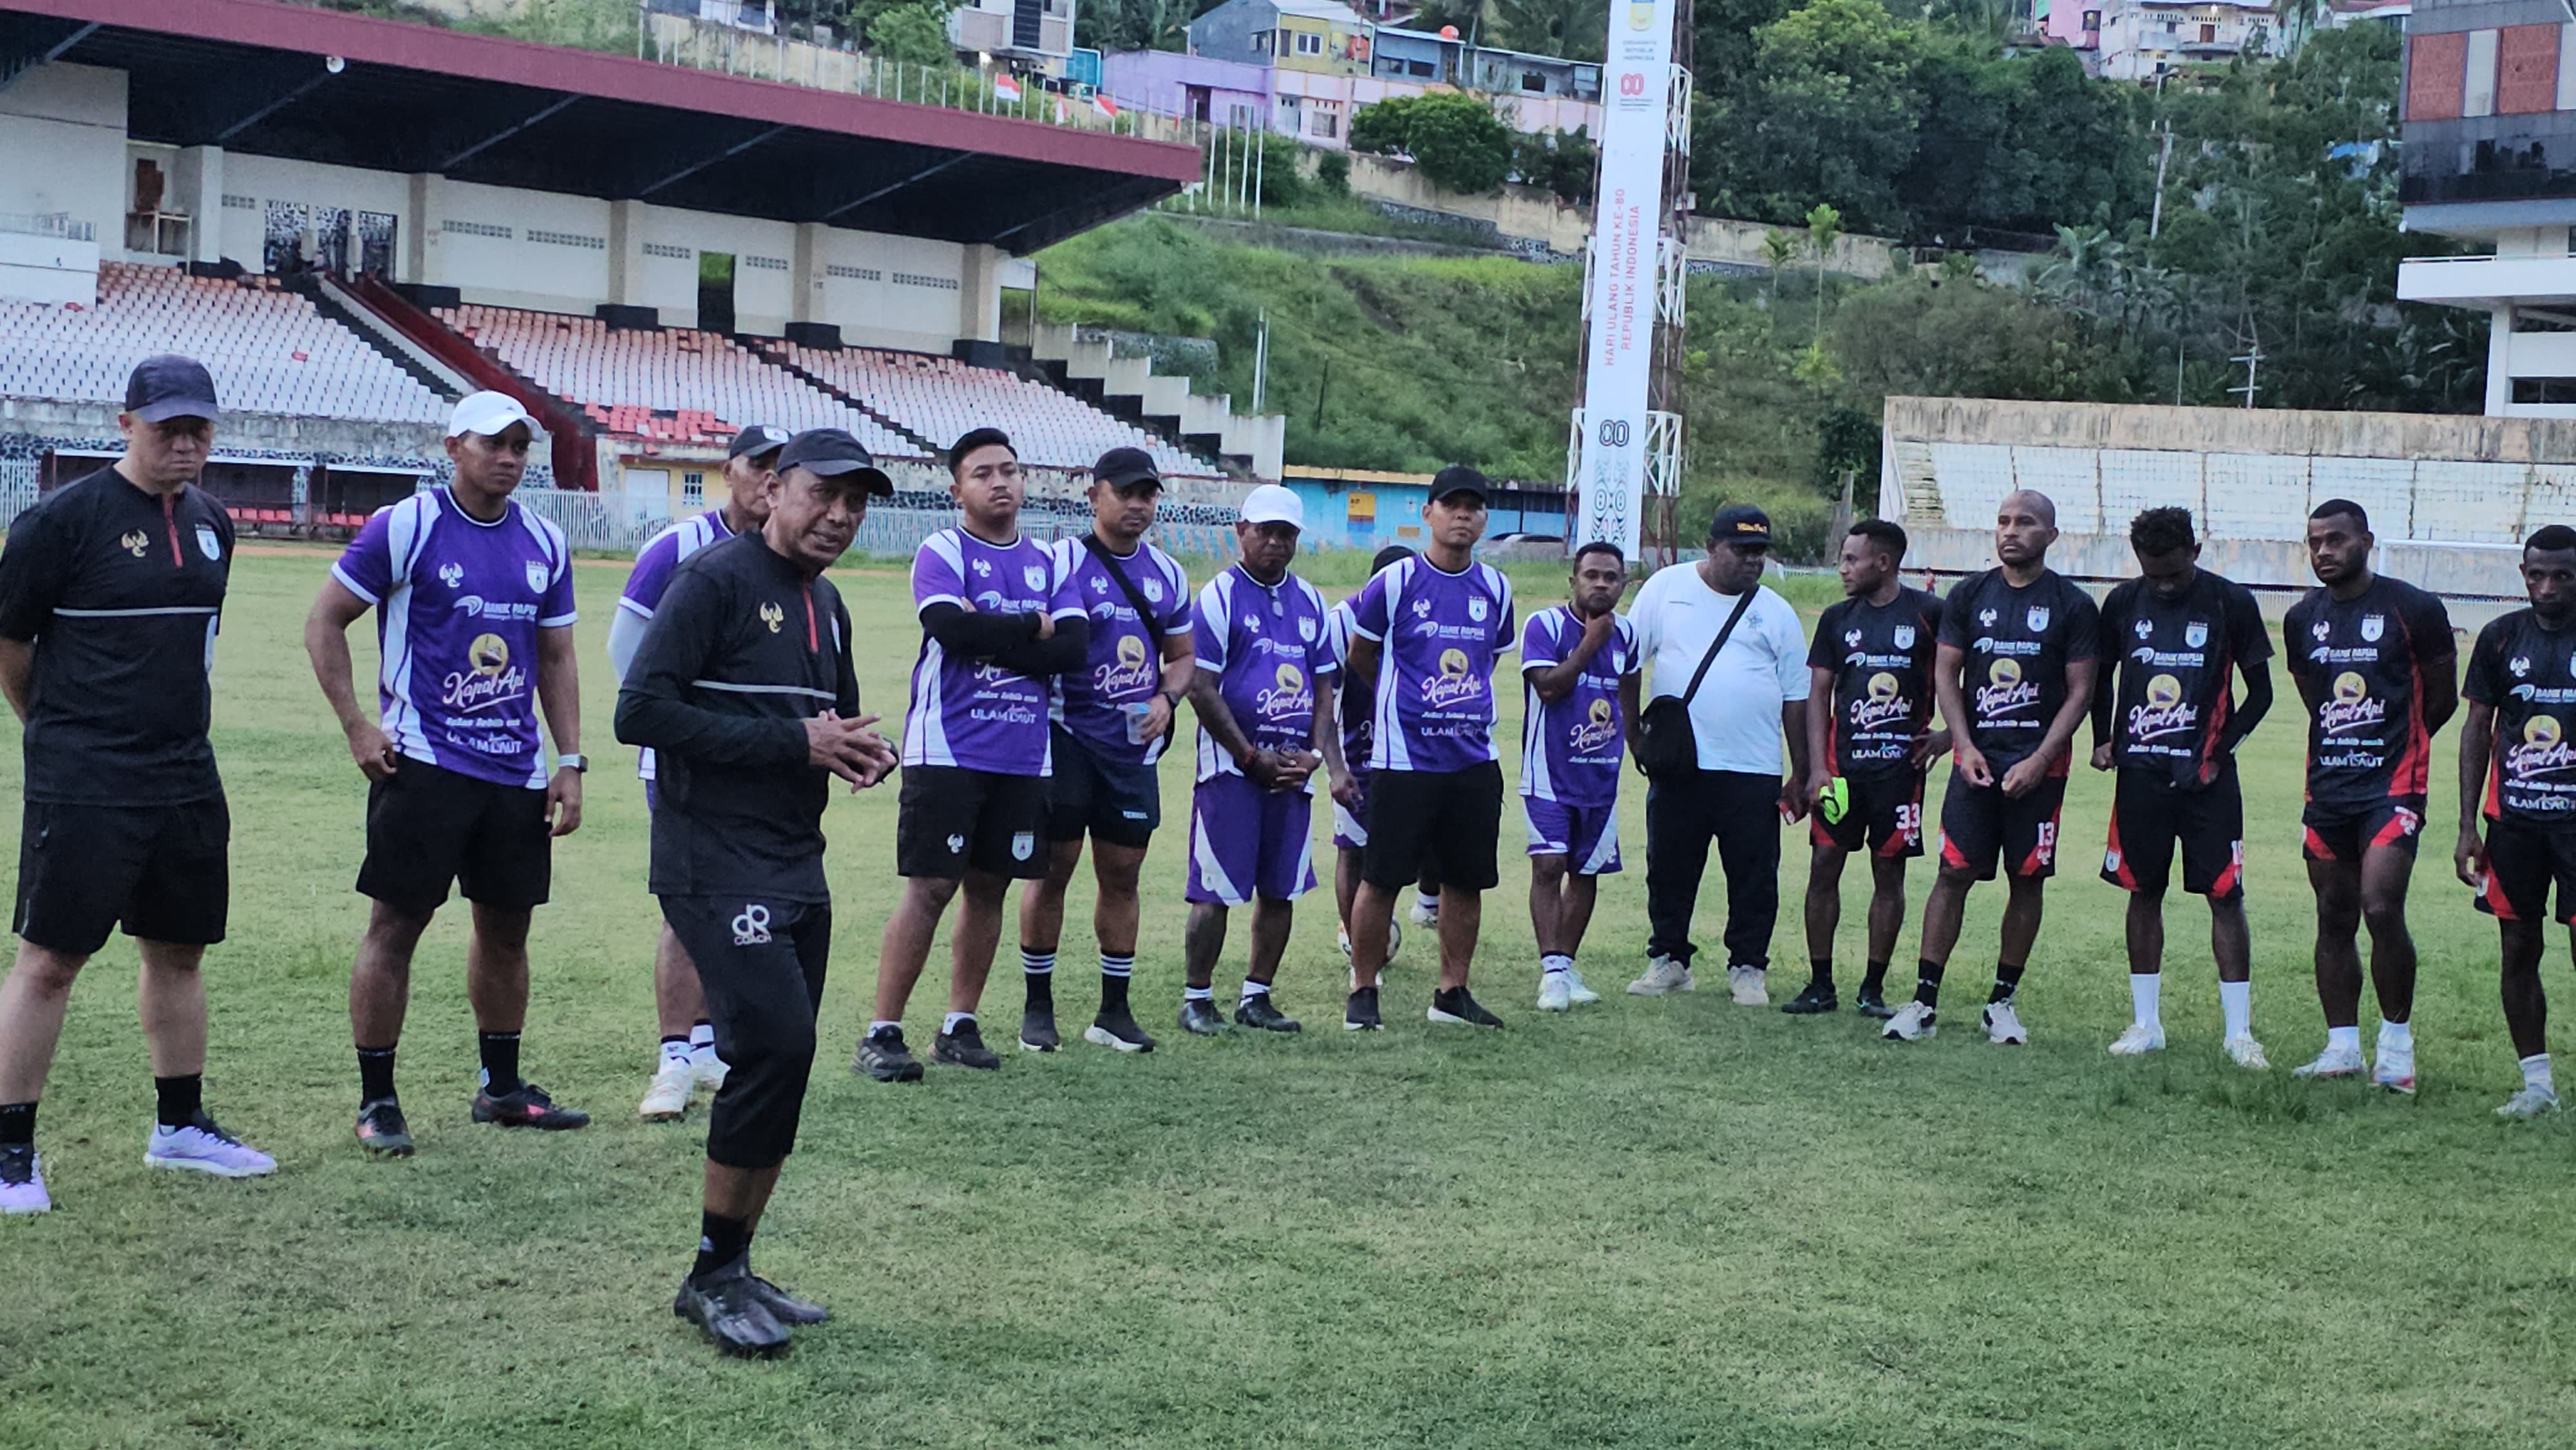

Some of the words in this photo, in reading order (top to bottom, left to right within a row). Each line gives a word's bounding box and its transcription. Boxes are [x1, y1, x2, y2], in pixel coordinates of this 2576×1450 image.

[1613, 189, 1625, 232] KE-80
[1609, 233, 1622, 278] TAHUN
[1625, 205, 1640, 279] INDONESIA
[1607, 284, 1620, 330] ULANG
[1621, 283, 1635, 350] REPUBLIK
[1604, 332, 1616, 366] HARI
[1599, 419, 1629, 447] 80
[442, 669, 498, 708] Kapal
[497, 666, 526, 695] Api
[1094, 663, 1140, 693] Kapal
[1421, 673, 1461, 704] Kapal
[1256, 688, 1298, 717] Kapal
[1851, 697, 1889, 725] Kapal
[1888, 696, 1913, 717] Api
[1976, 684, 2012, 713] Kapal
[2012, 682, 2039, 702] Api
[2320, 698, 2357, 728] Kapal
[2354, 697, 2385, 722] Api
[971, 708, 1009, 721] ULAM
[2128, 705, 2168, 735] Kapal
[2166, 702, 2197, 728] Api
[2349, 756, 2385, 768] LAUT
[1895, 804, 1920, 830] 33
[2038, 822, 2054, 846] 13
